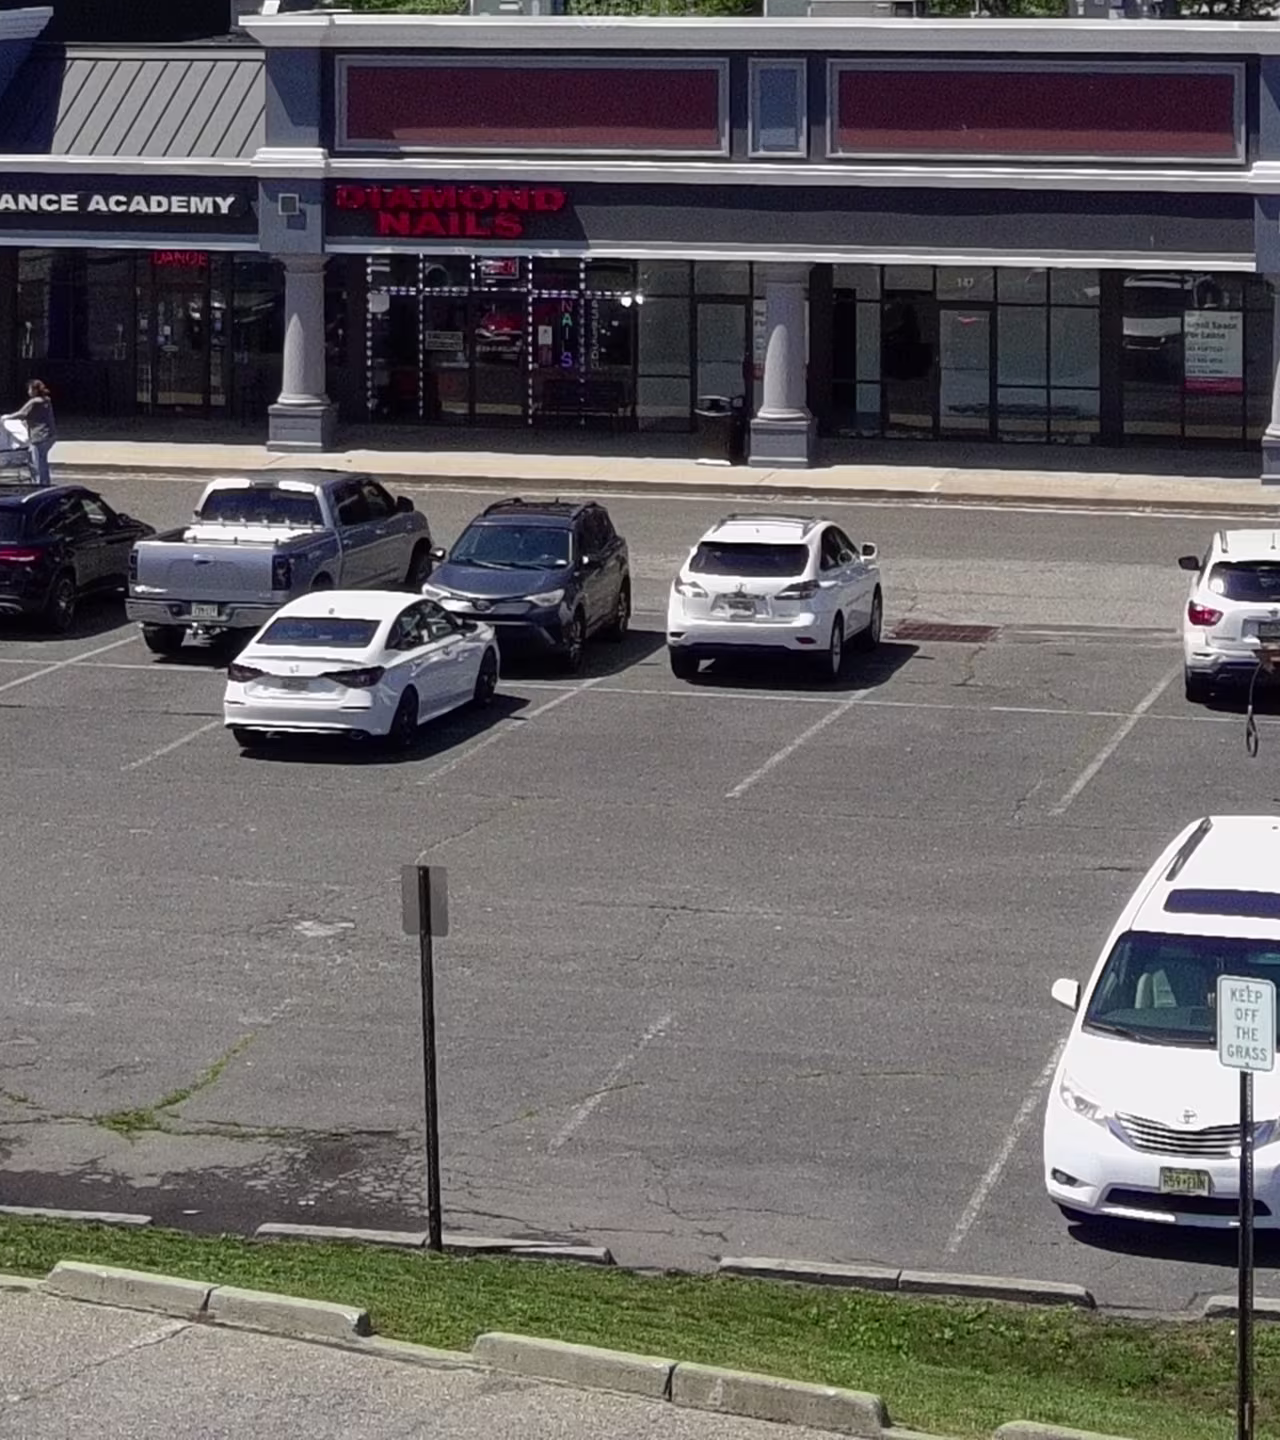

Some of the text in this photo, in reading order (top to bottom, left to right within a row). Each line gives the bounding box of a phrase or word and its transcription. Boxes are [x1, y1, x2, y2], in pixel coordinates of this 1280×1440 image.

[87, 194, 235, 214] ACADEMY
[335, 185, 566, 210] DIAMOND
[377, 211, 524, 237] NAILS
[1230, 987, 1263, 1004] KEEP
[1234, 1007, 1260, 1023] OFF
[1234, 1025, 1259, 1042] THE
[1227, 1044, 1267, 1062] GRASS
